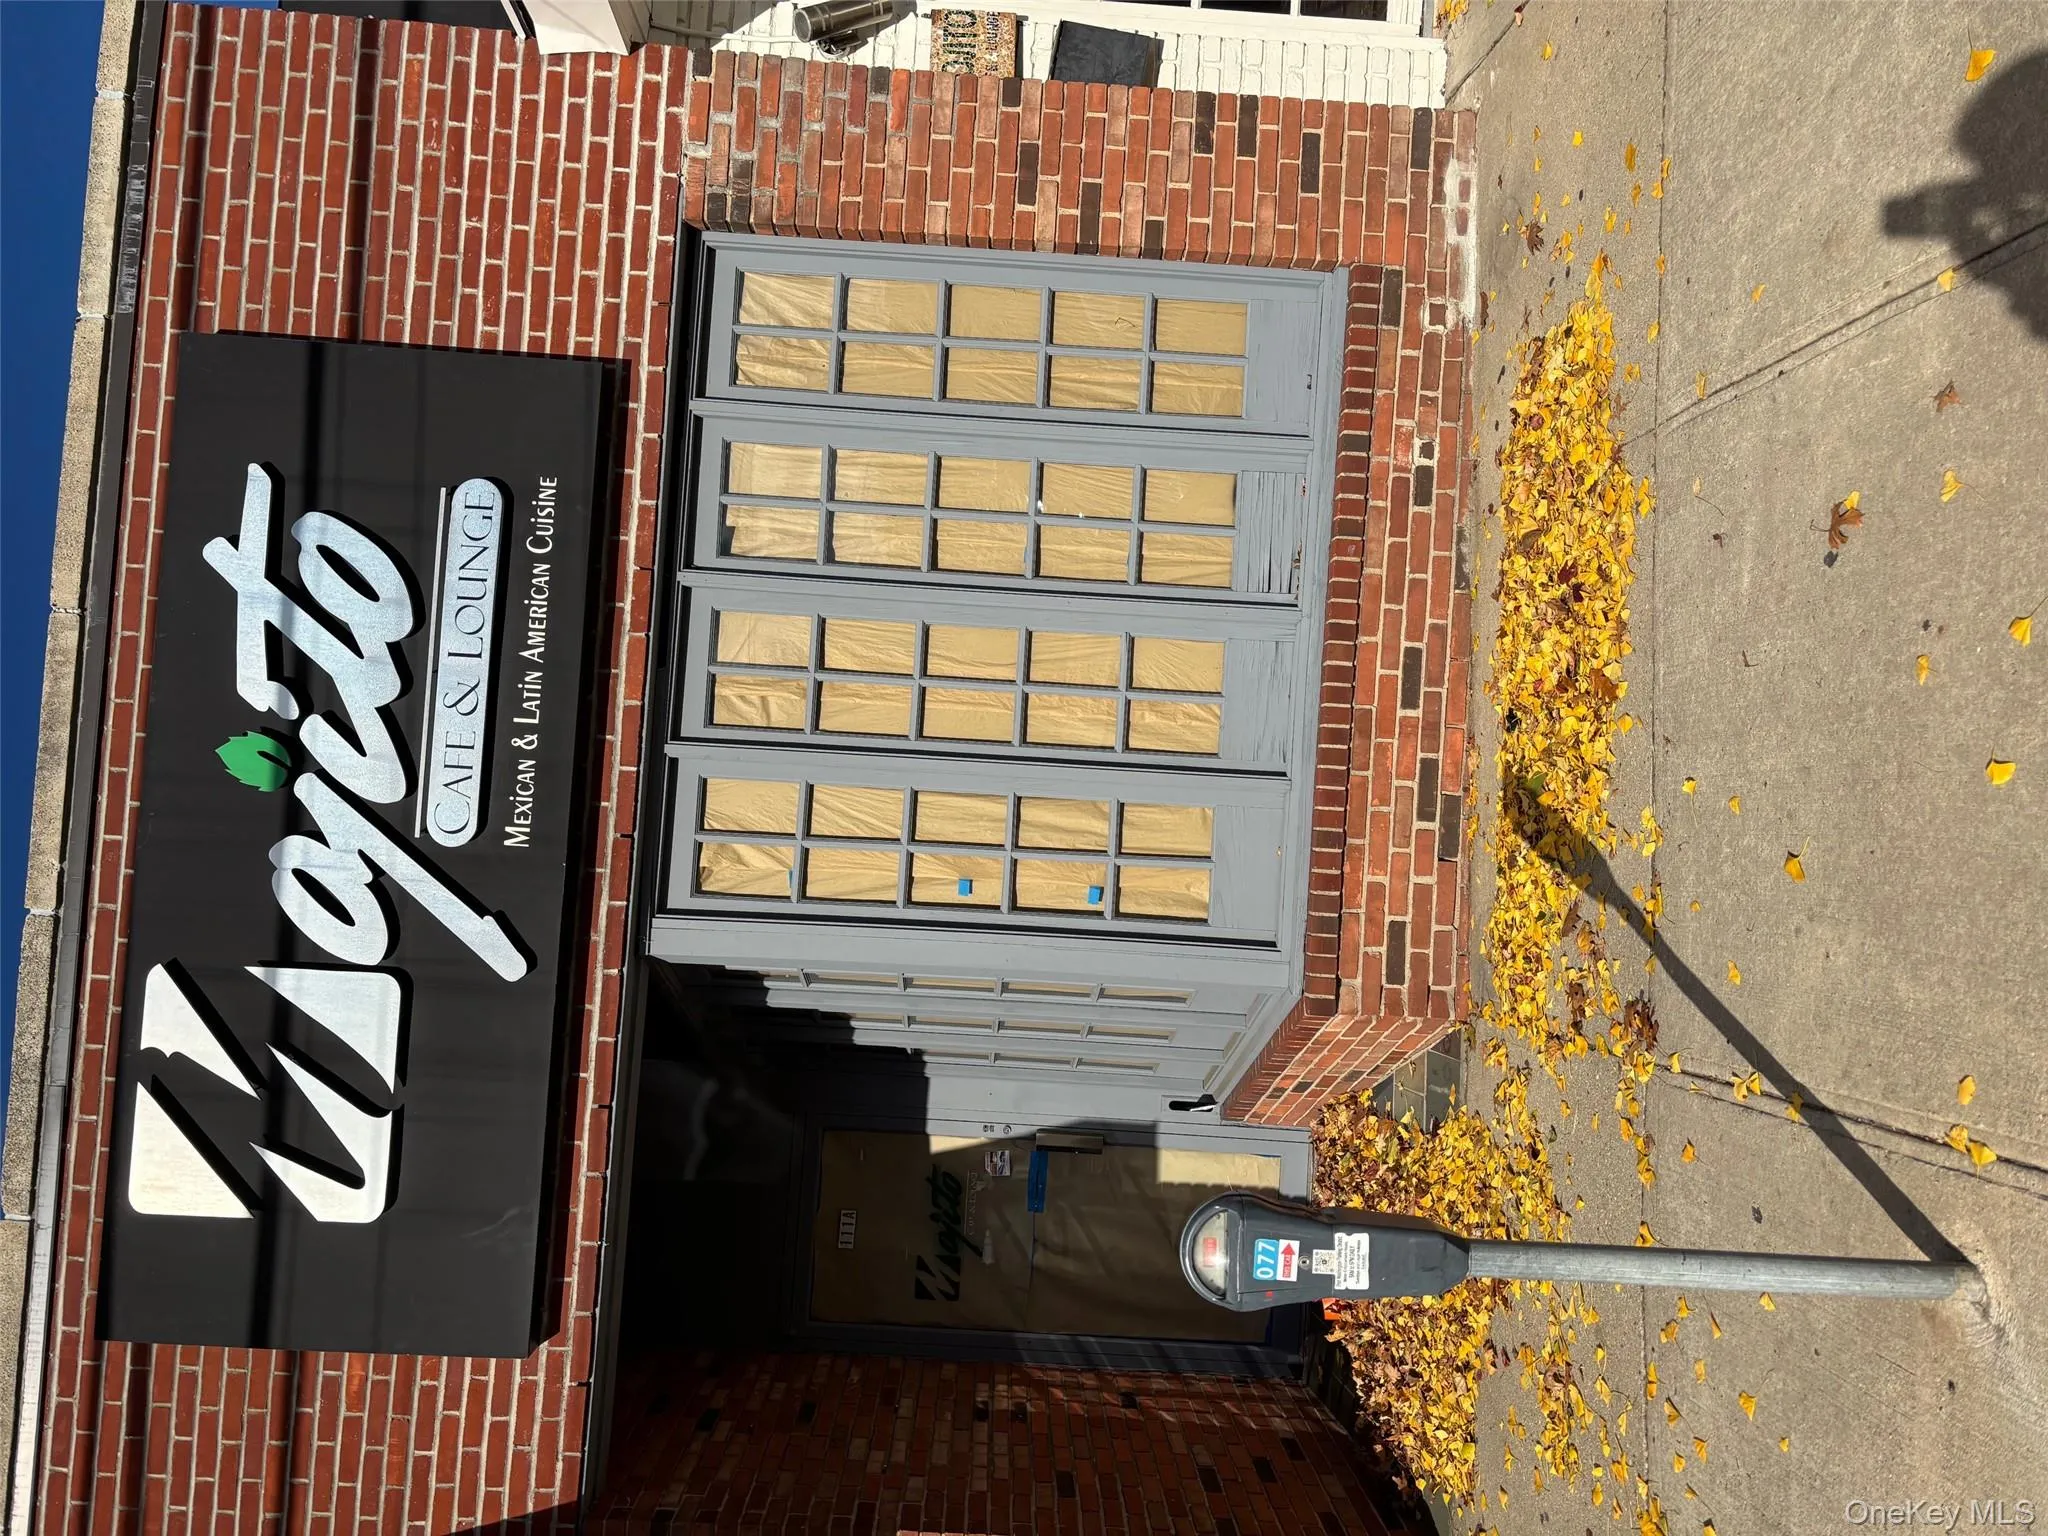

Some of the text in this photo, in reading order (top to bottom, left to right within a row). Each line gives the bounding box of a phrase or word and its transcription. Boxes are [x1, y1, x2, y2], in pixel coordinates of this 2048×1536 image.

[985, 11, 1001, 50] LOUNGE
[433, 490, 496, 835] CAFE & LOUNGE
[510, 733, 538, 750] &
[1256, 1241, 1276, 1279] 077
